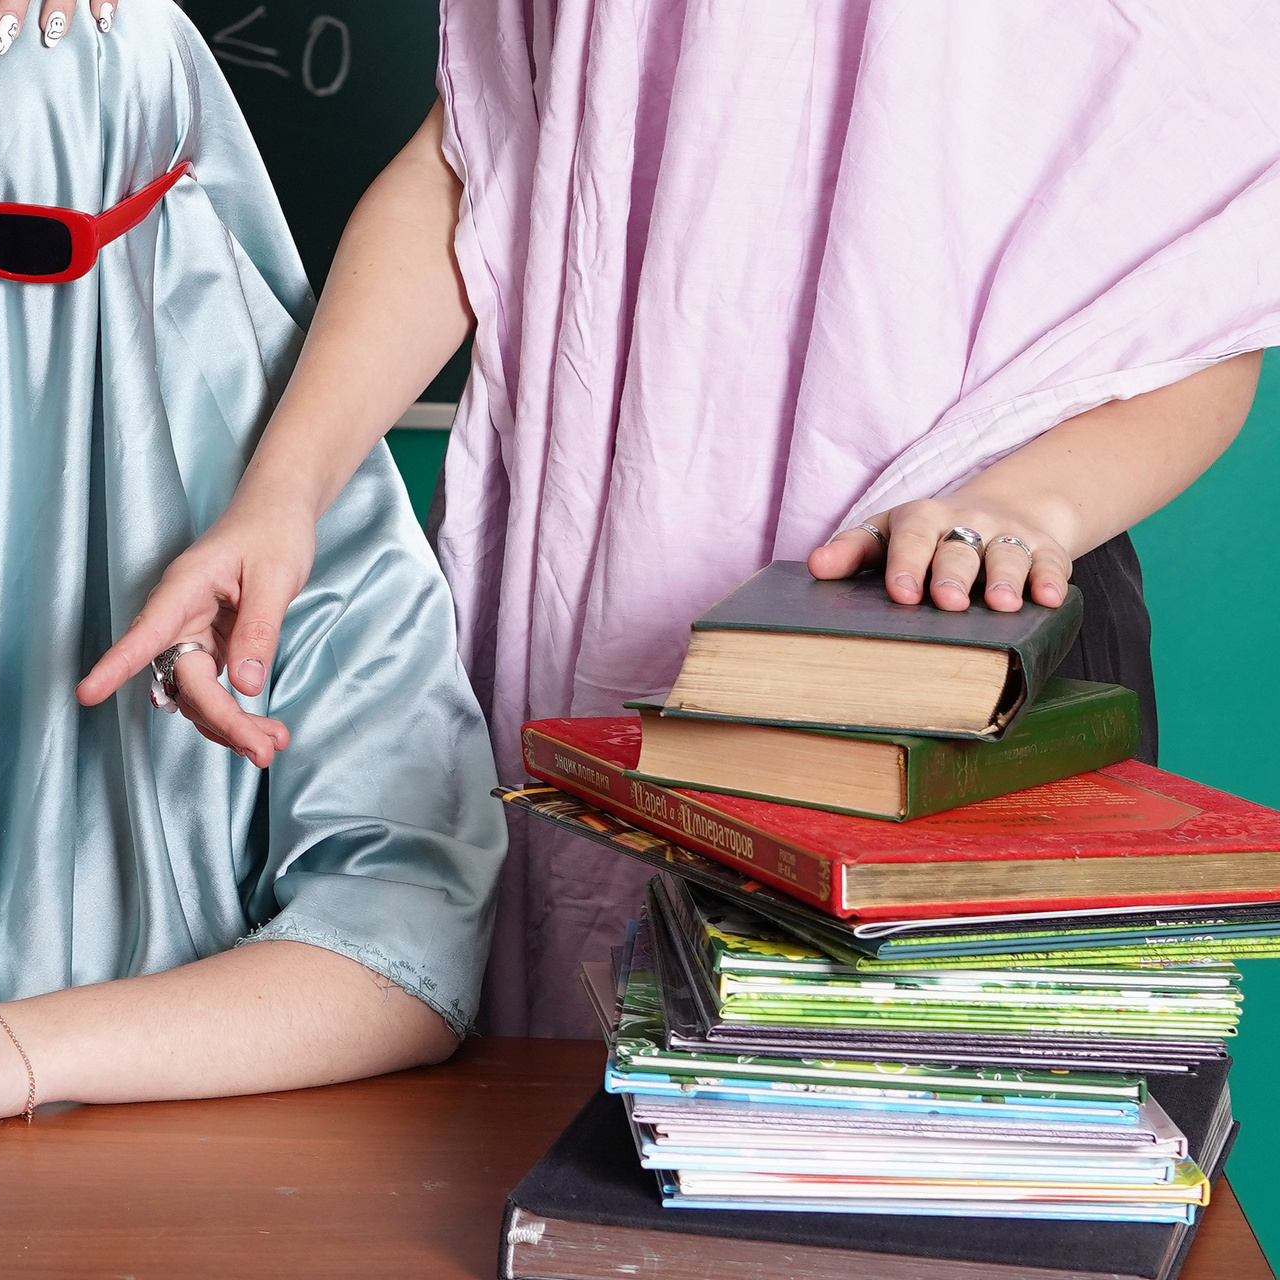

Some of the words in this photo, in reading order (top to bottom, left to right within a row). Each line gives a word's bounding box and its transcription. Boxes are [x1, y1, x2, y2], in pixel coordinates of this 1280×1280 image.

[554, 752, 611, 791] ЭНЦИКЛОПЕДИЯ
[630, 778, 668, 821] Царей
[677, 800, 754, 860] Императоров
